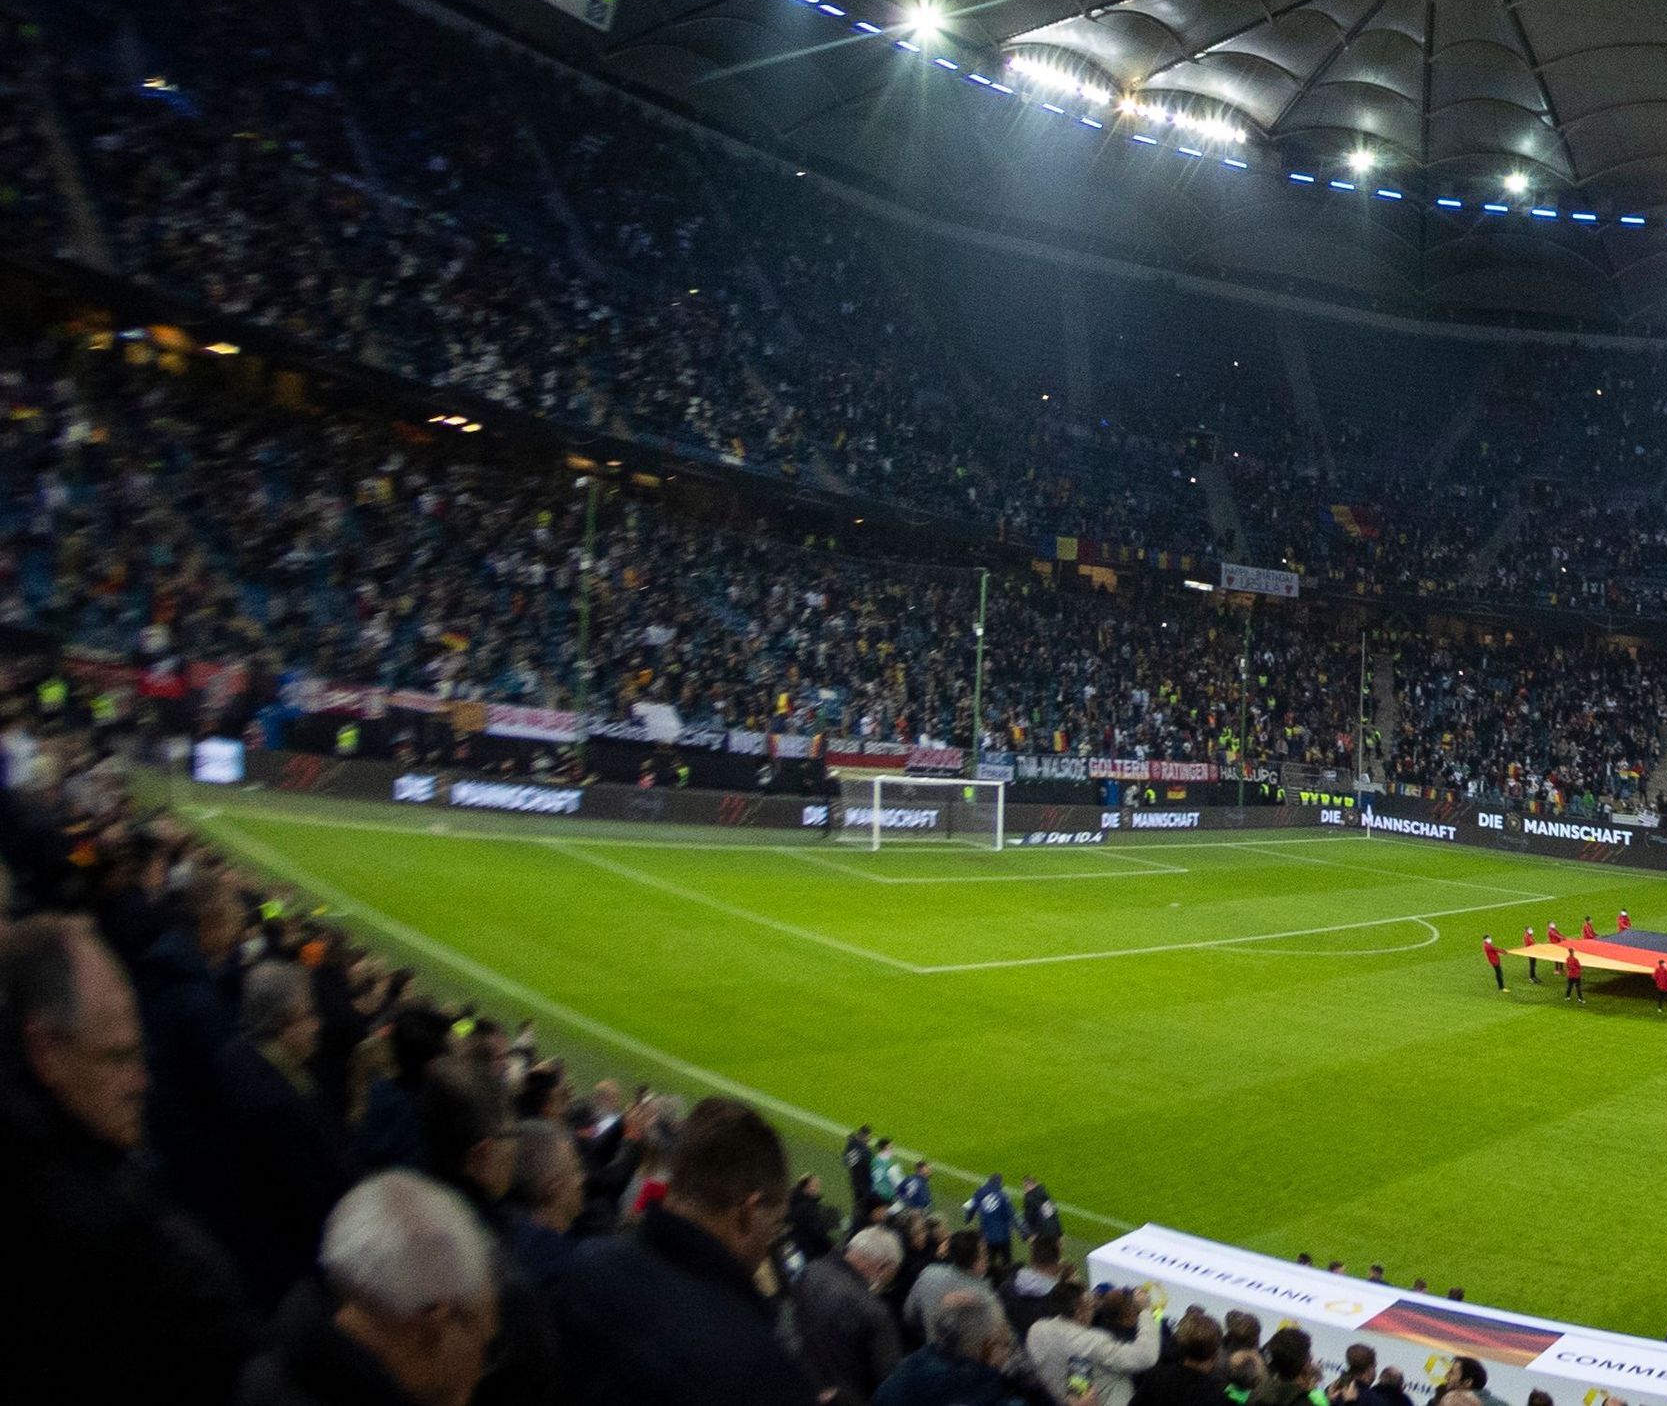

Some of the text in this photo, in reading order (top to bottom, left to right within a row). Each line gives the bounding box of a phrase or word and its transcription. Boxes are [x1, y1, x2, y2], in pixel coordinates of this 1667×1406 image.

[1101, 812, 1200, 828] DIE MANNSCHAFT
[1321, 809, 1457, 840] DIE MANNSCHAFT
[1478, 812, 1633, 845] DIE MANNSCHAFT
[1119, 1244, 1318, 1305] COMMERZBANK
